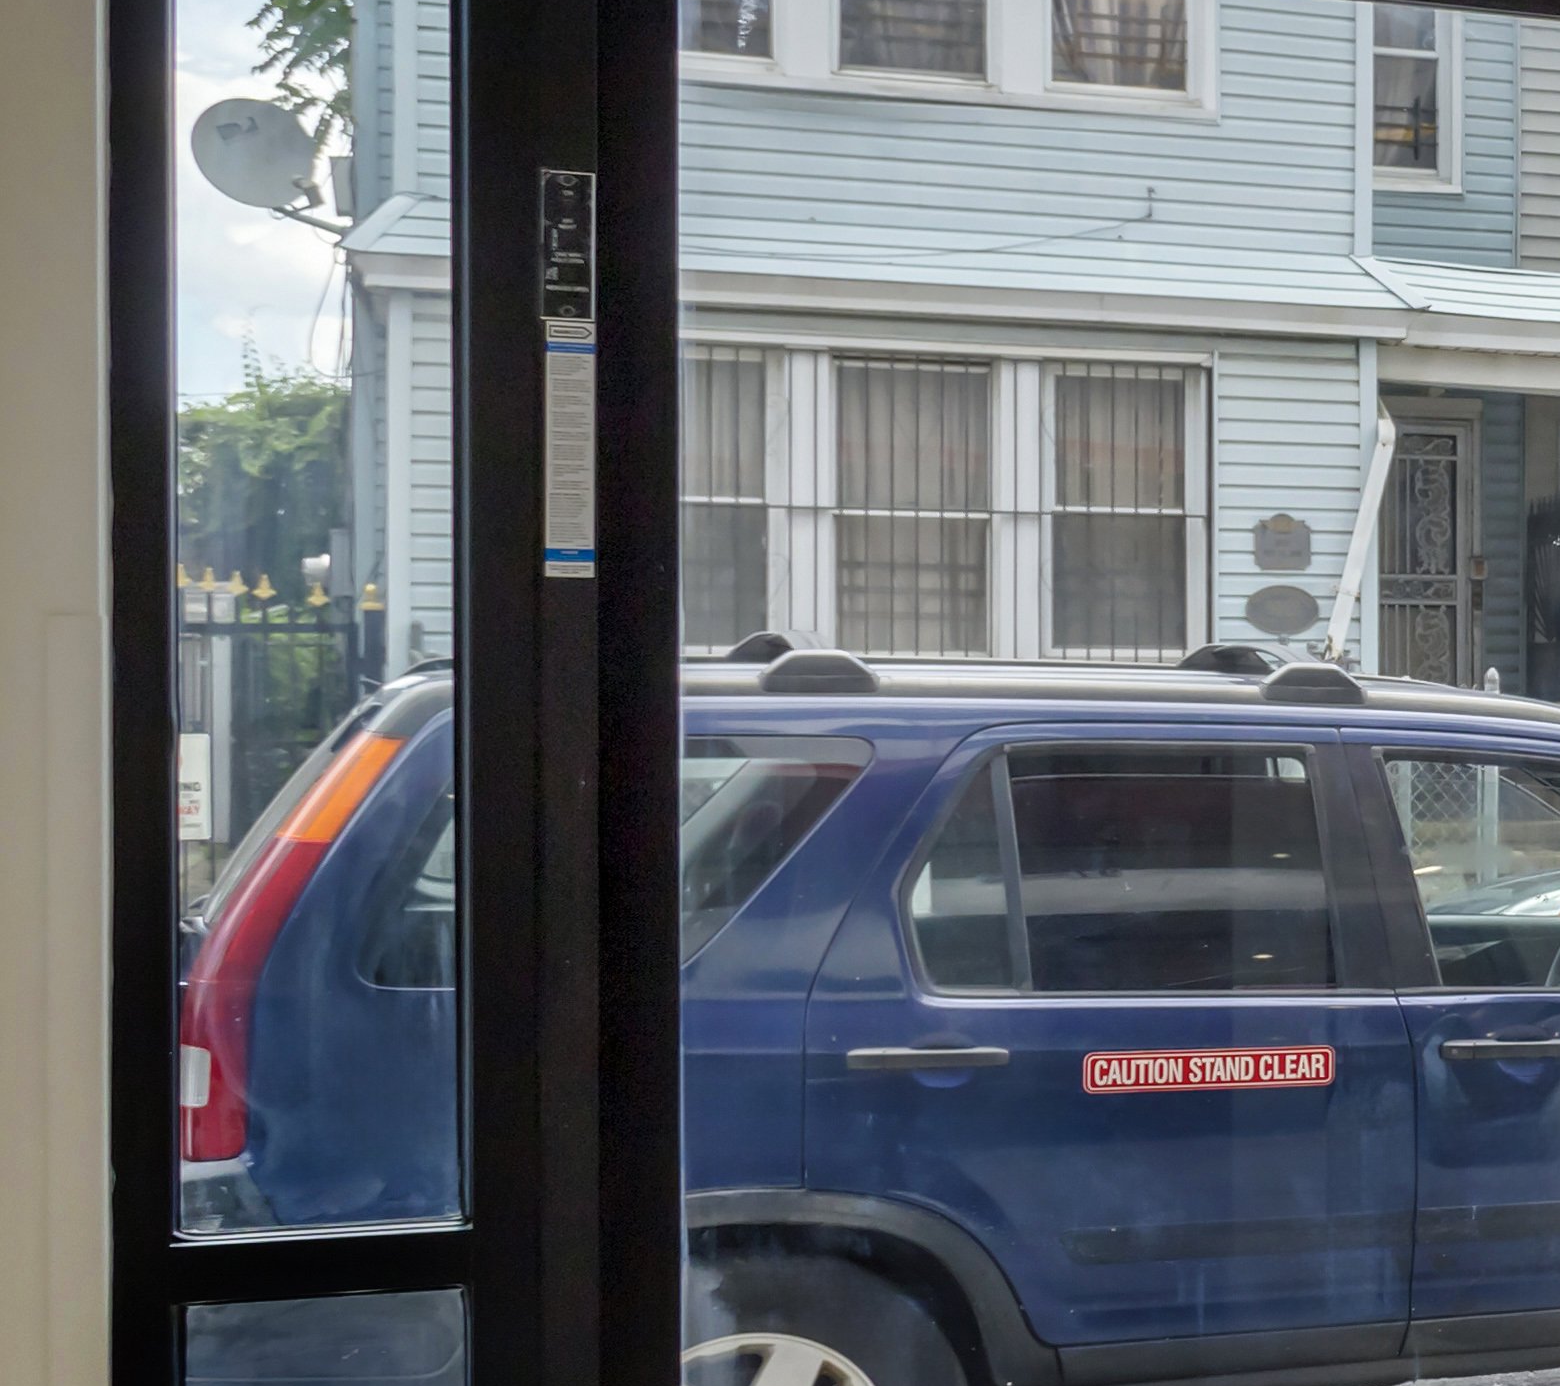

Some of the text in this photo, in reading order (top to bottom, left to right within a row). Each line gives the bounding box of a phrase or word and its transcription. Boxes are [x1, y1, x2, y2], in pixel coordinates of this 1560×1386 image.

[1094, 1054, 1326, 1086] CAUTION STAND CLEAR
